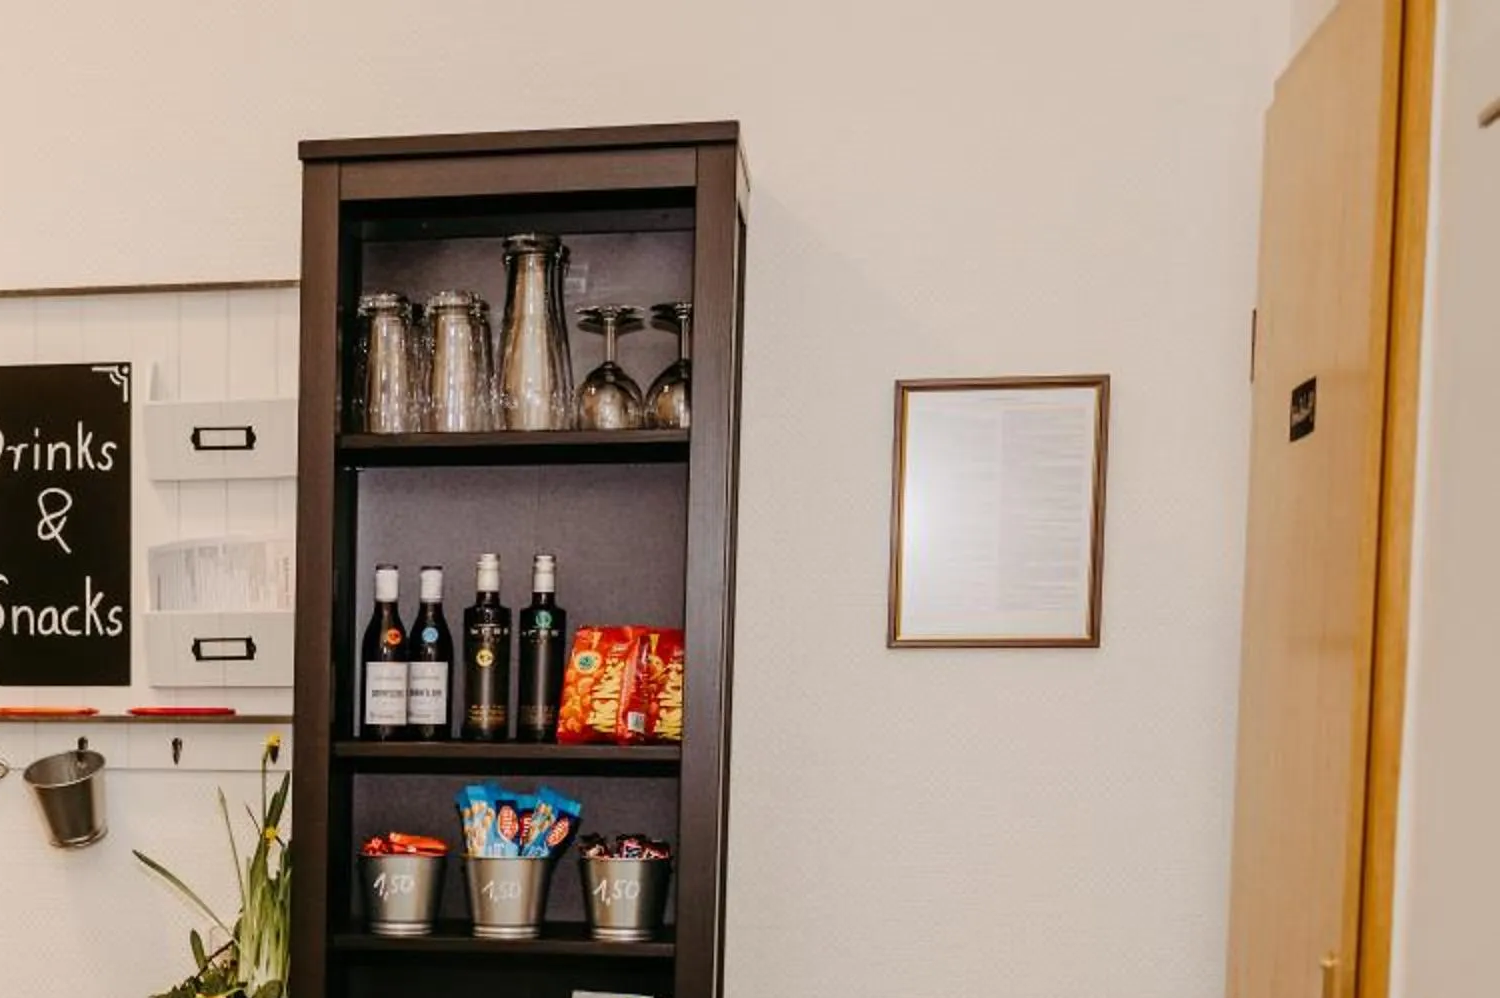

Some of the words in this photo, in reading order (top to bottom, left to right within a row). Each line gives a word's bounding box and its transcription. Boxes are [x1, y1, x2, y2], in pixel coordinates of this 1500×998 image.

[37, 487, 73, 554] &
[373, 873, 414, 900] 1,50
[482, 880, 522, 901] 1,50
[593, 879, 641, 906] 1,50
